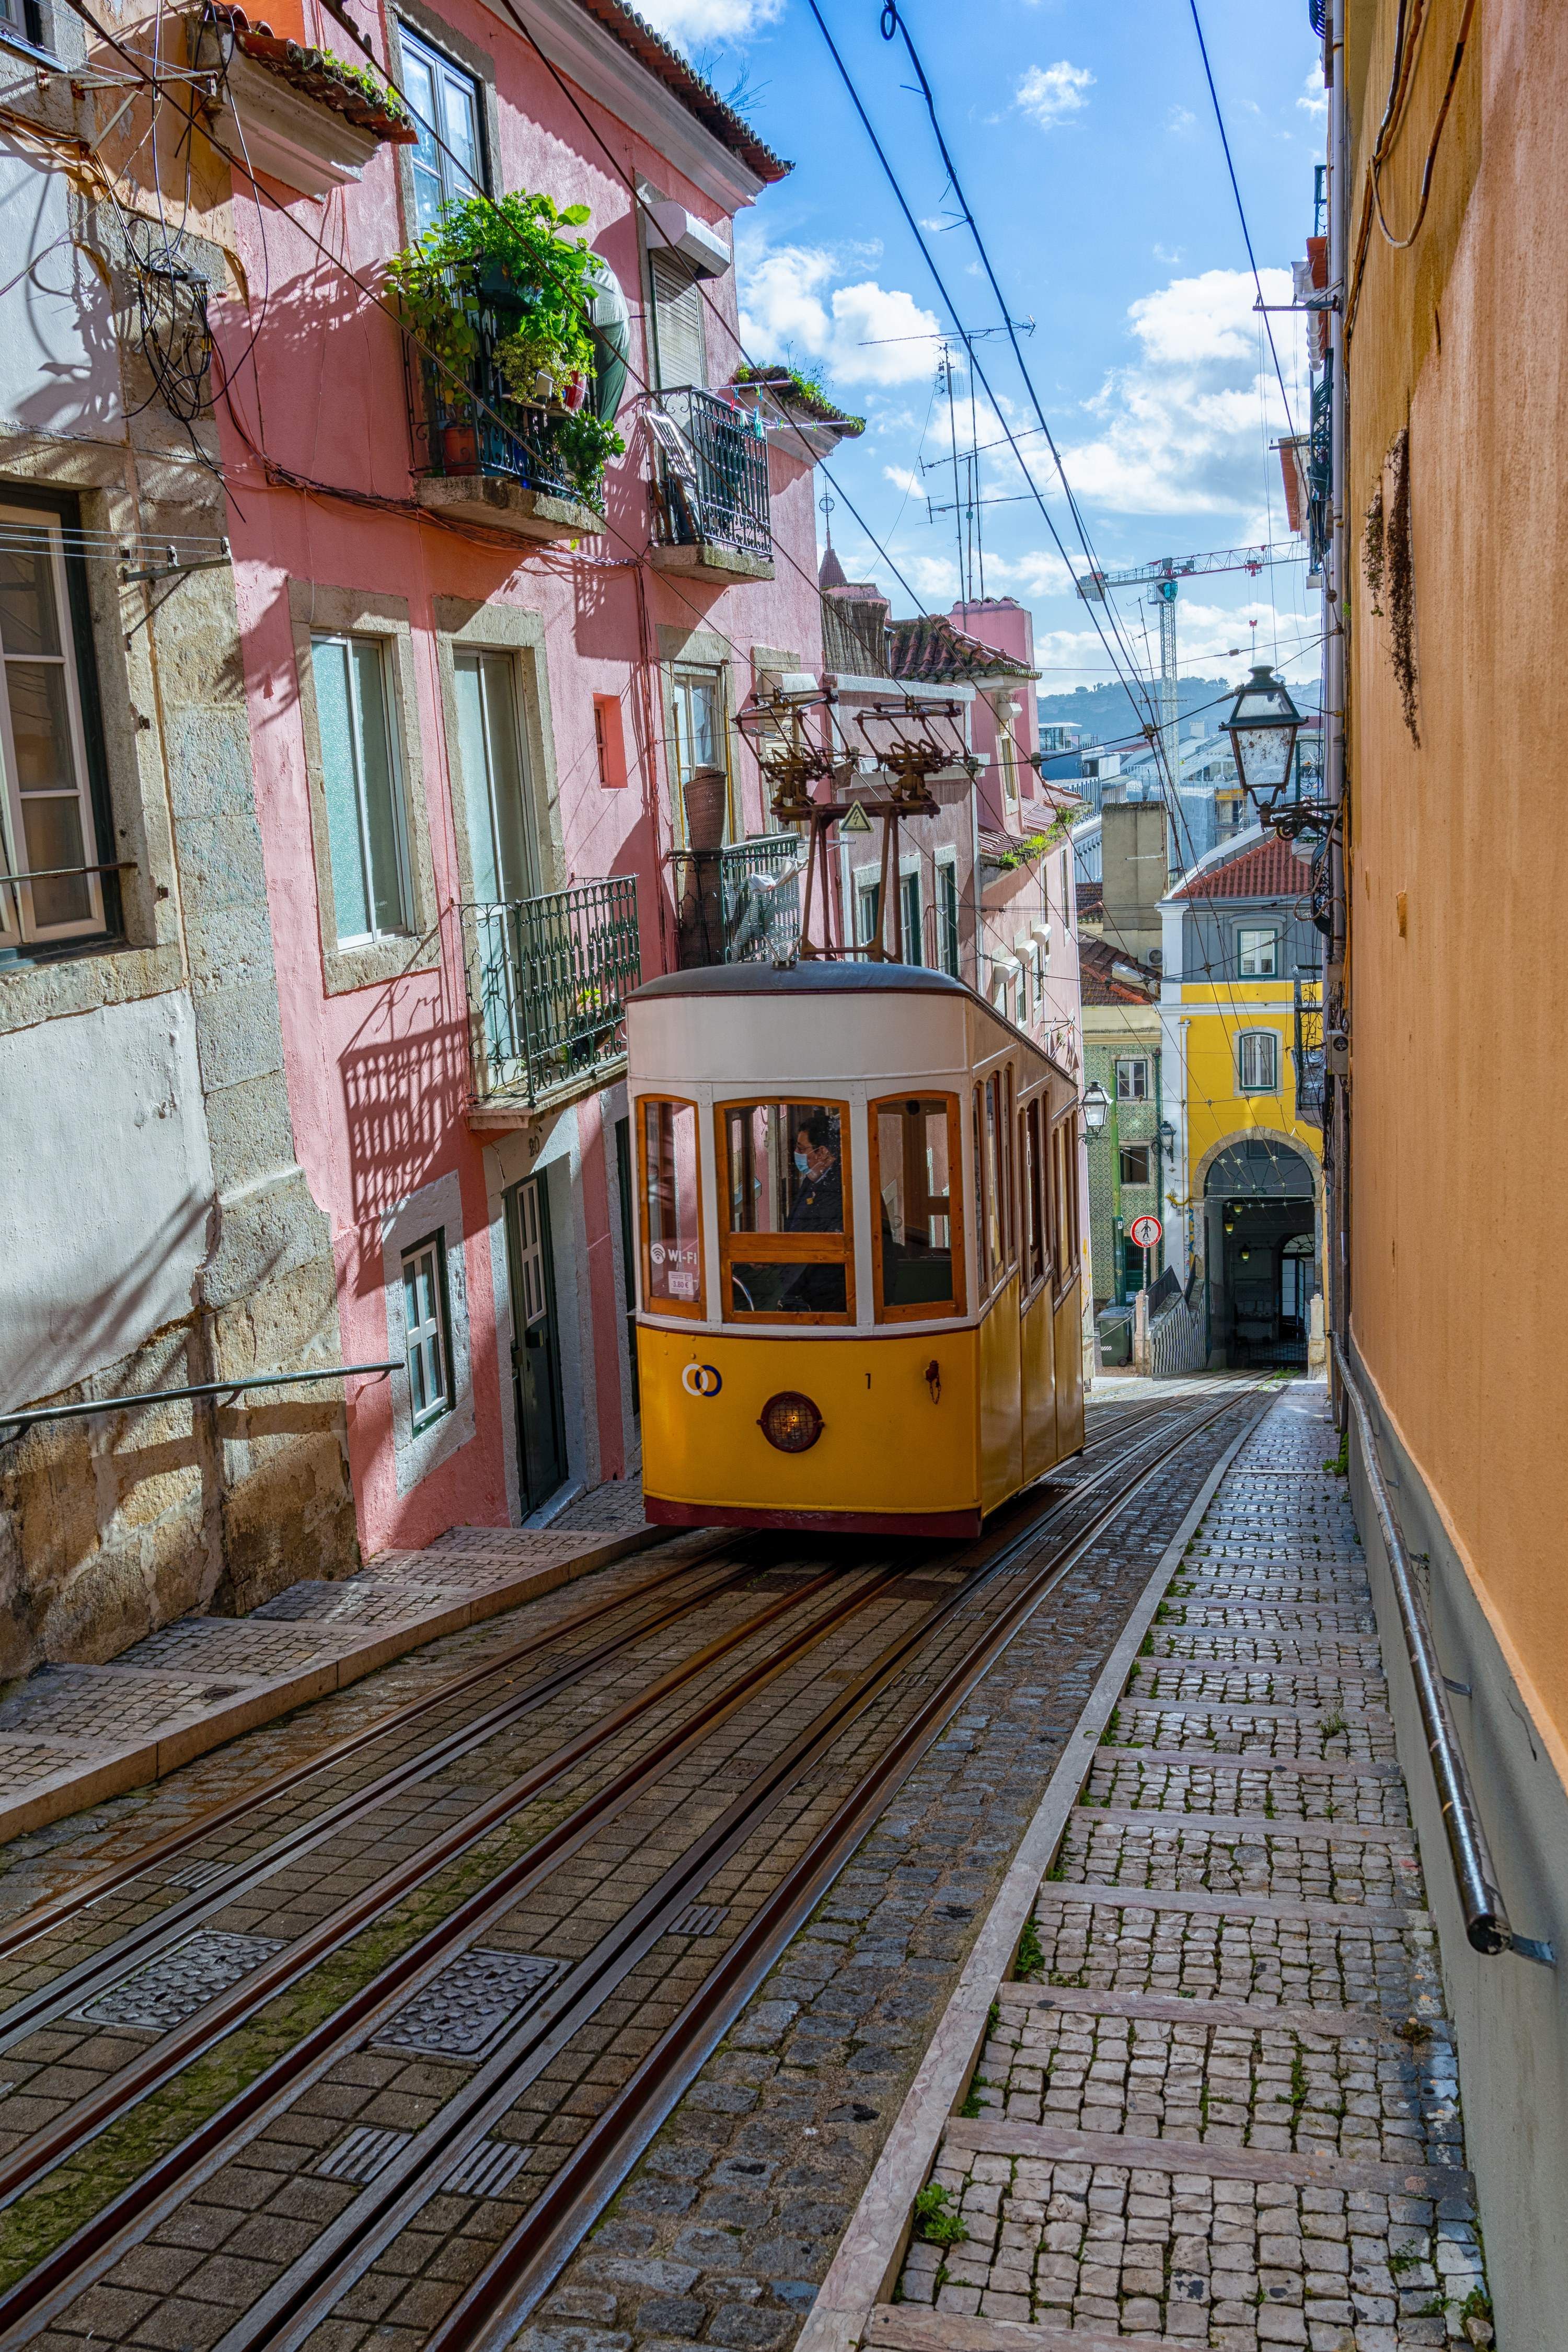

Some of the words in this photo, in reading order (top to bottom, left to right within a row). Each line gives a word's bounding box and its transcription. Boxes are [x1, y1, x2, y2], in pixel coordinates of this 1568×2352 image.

[529, 1135, 539, 1157] 20
[667, 1249, 697, 1264] WI-FI
[864, 1373, 871, 1389] 1
